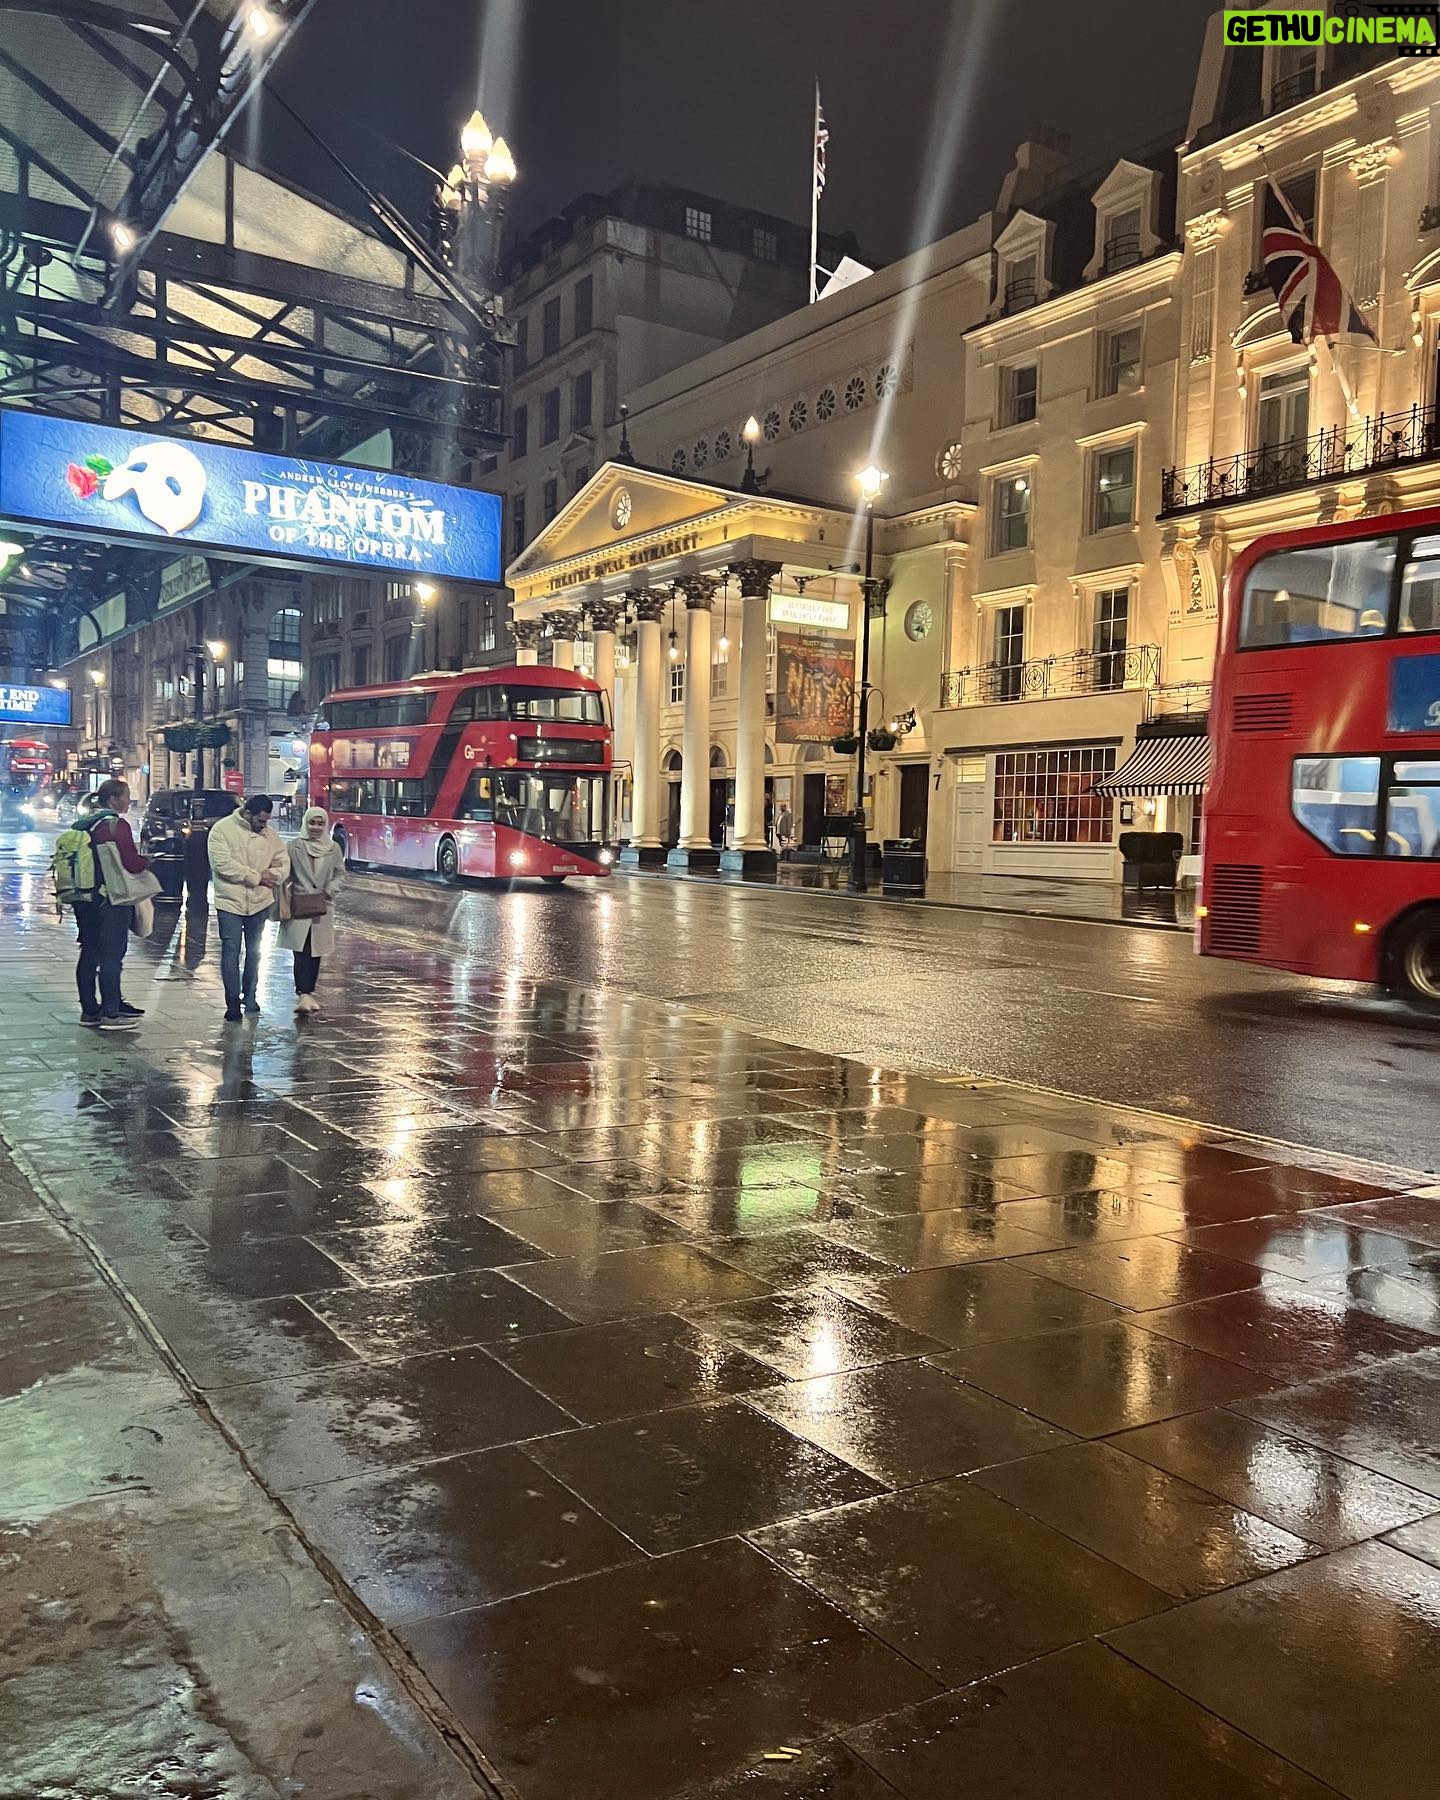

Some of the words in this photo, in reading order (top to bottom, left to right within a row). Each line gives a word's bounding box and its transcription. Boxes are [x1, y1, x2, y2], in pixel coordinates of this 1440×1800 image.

[280, 471, 324, 485] ANDREW
[328, 478, 361, 491] LLOYD
[242, 480, 446, 545] PHANTOM
[269, 525, 297, 544] OF
[308, 531, 348, 551] THE
[355, 537, 422, 562] OPERA
[9, 688, 39, 702] END
[933, 774, 942, 791] 7
